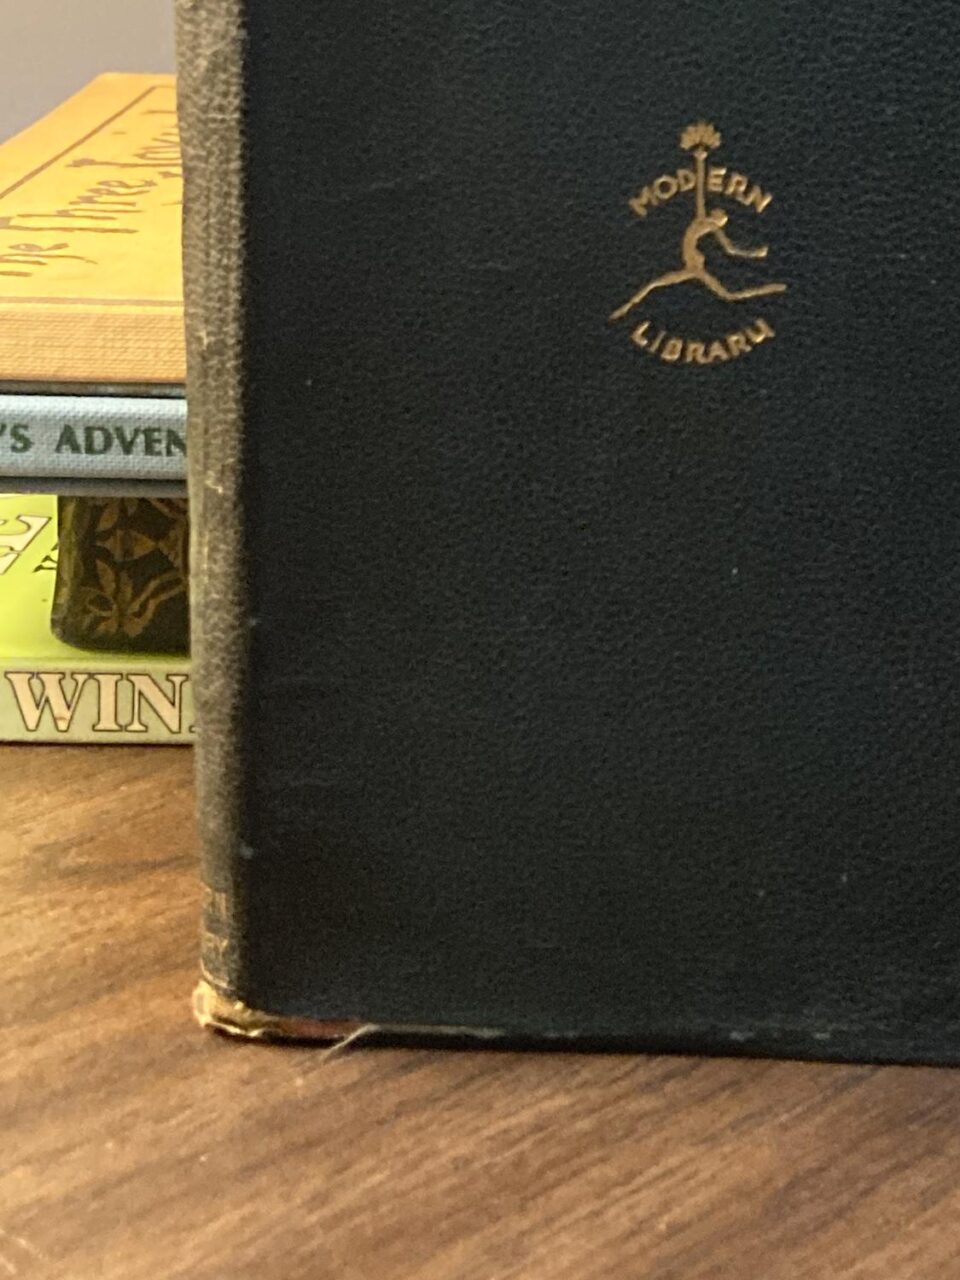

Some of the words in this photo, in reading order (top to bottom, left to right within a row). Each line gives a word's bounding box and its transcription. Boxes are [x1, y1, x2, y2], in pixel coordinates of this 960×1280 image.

[628, 167, 773, 217] MODERN
[630, 319, 776, 365] LIBRARY
[5, 671, 196, 734] WIN
